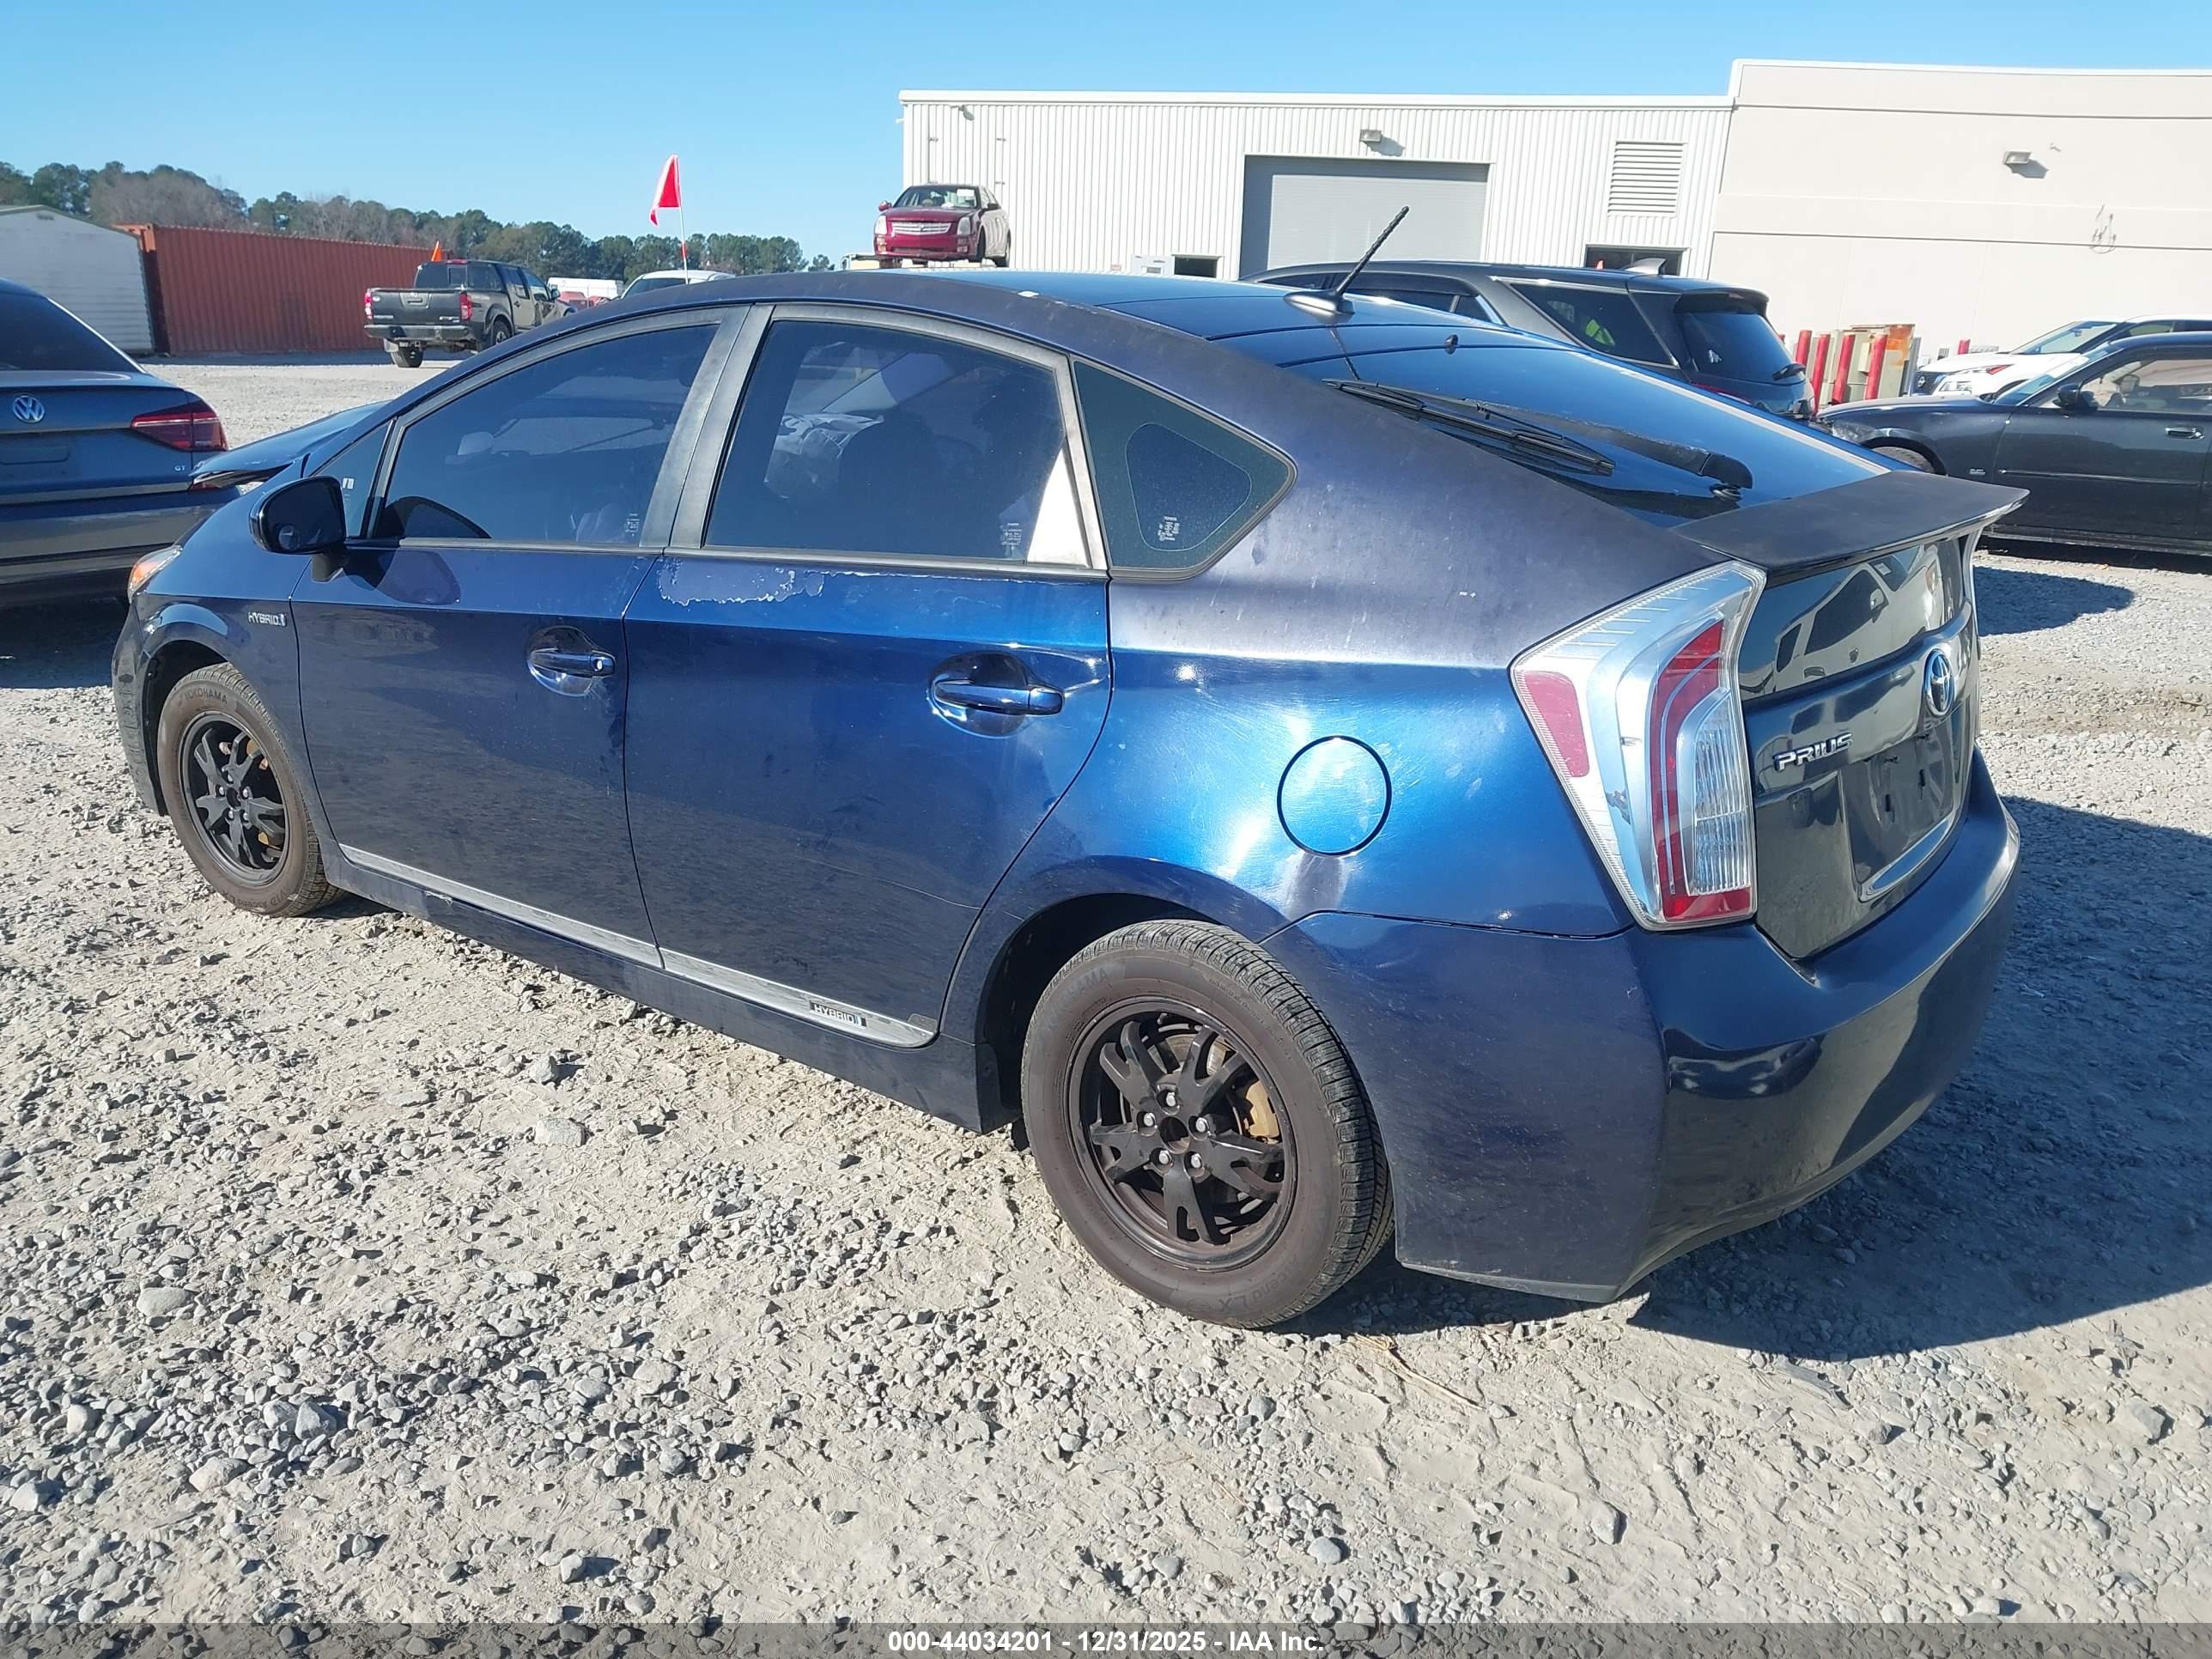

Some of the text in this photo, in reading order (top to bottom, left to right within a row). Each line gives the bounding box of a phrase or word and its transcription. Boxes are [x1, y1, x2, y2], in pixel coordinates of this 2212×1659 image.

[13, 395, 45, 422] VW
[247, 611, 280, 626] HYBRID
[1773, 732, 1854, 771] PRIUS
[812, 1003, 856, 1025] HYBRID
